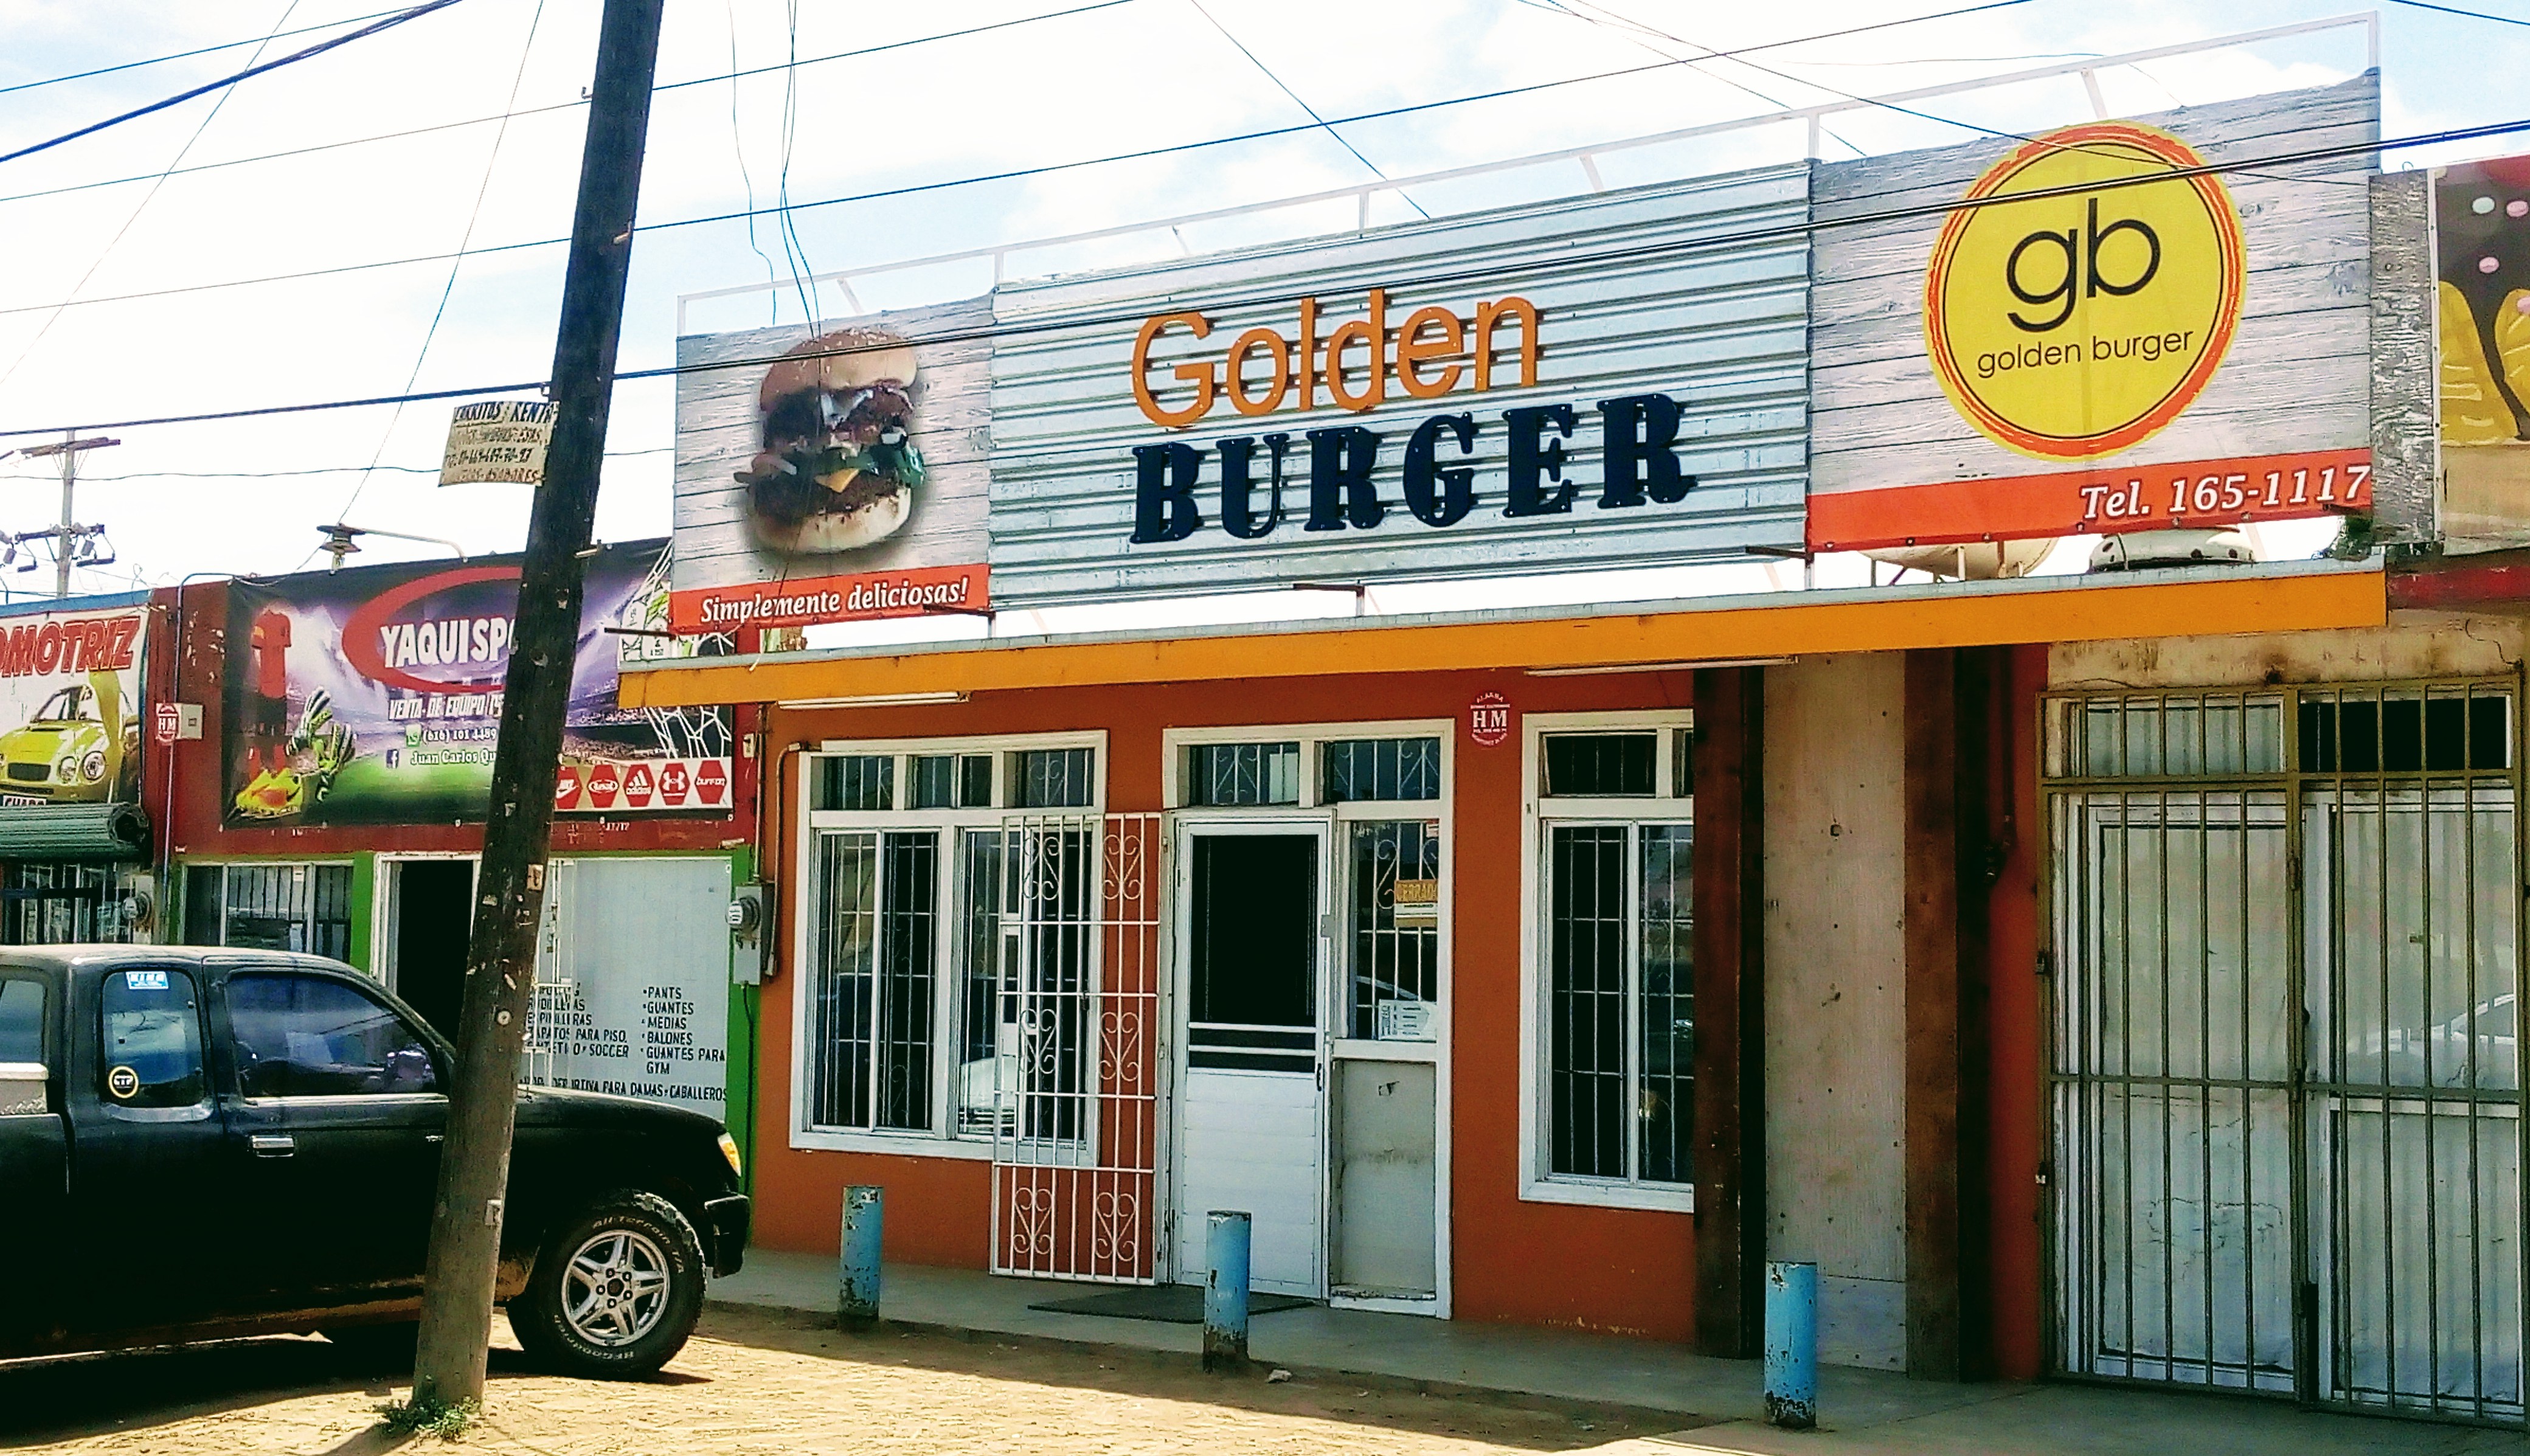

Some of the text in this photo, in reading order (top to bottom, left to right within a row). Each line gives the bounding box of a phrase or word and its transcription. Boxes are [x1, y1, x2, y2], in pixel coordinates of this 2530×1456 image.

[2007, 198, 2160, 332] gb
[1131, 288, 1539, 428] Golden
[1977, 328, 2194, 378] golden burger
[1129, 392, 1697, 544] BURGER
[2081, 465, 2371, 521] Tel. 165-1117
[701, 577, 970, 623] Simplemente deliciosas!
[470, 617, 516, 662] SP
[422, 729, 450, 744] (616)
[453, 730, 470, 740] 101
[411, 750, 439, 766] Juan
[442, 749, 478, 765] Carlos
[648, 986, 682, 999] PANTS
[647, 1001, 694, 1015] GUANTES
[647, 1016, 687, 1030] MEDIAS
[575, 1028, 600, 1041] PARA
[647, 1031, 693, 1045] BALONES
[589, 1043, 629, 1058] SOCCER
[646, 1046, 726, 1063] GUANTES PARA
[646, 1061, 670, 1075] GYM
[603, 1081, 626, 1095] PARA
[630, 1082, 664, 1097] DAMAS
[669, 1085, 727, 1101] CABALLEROS
